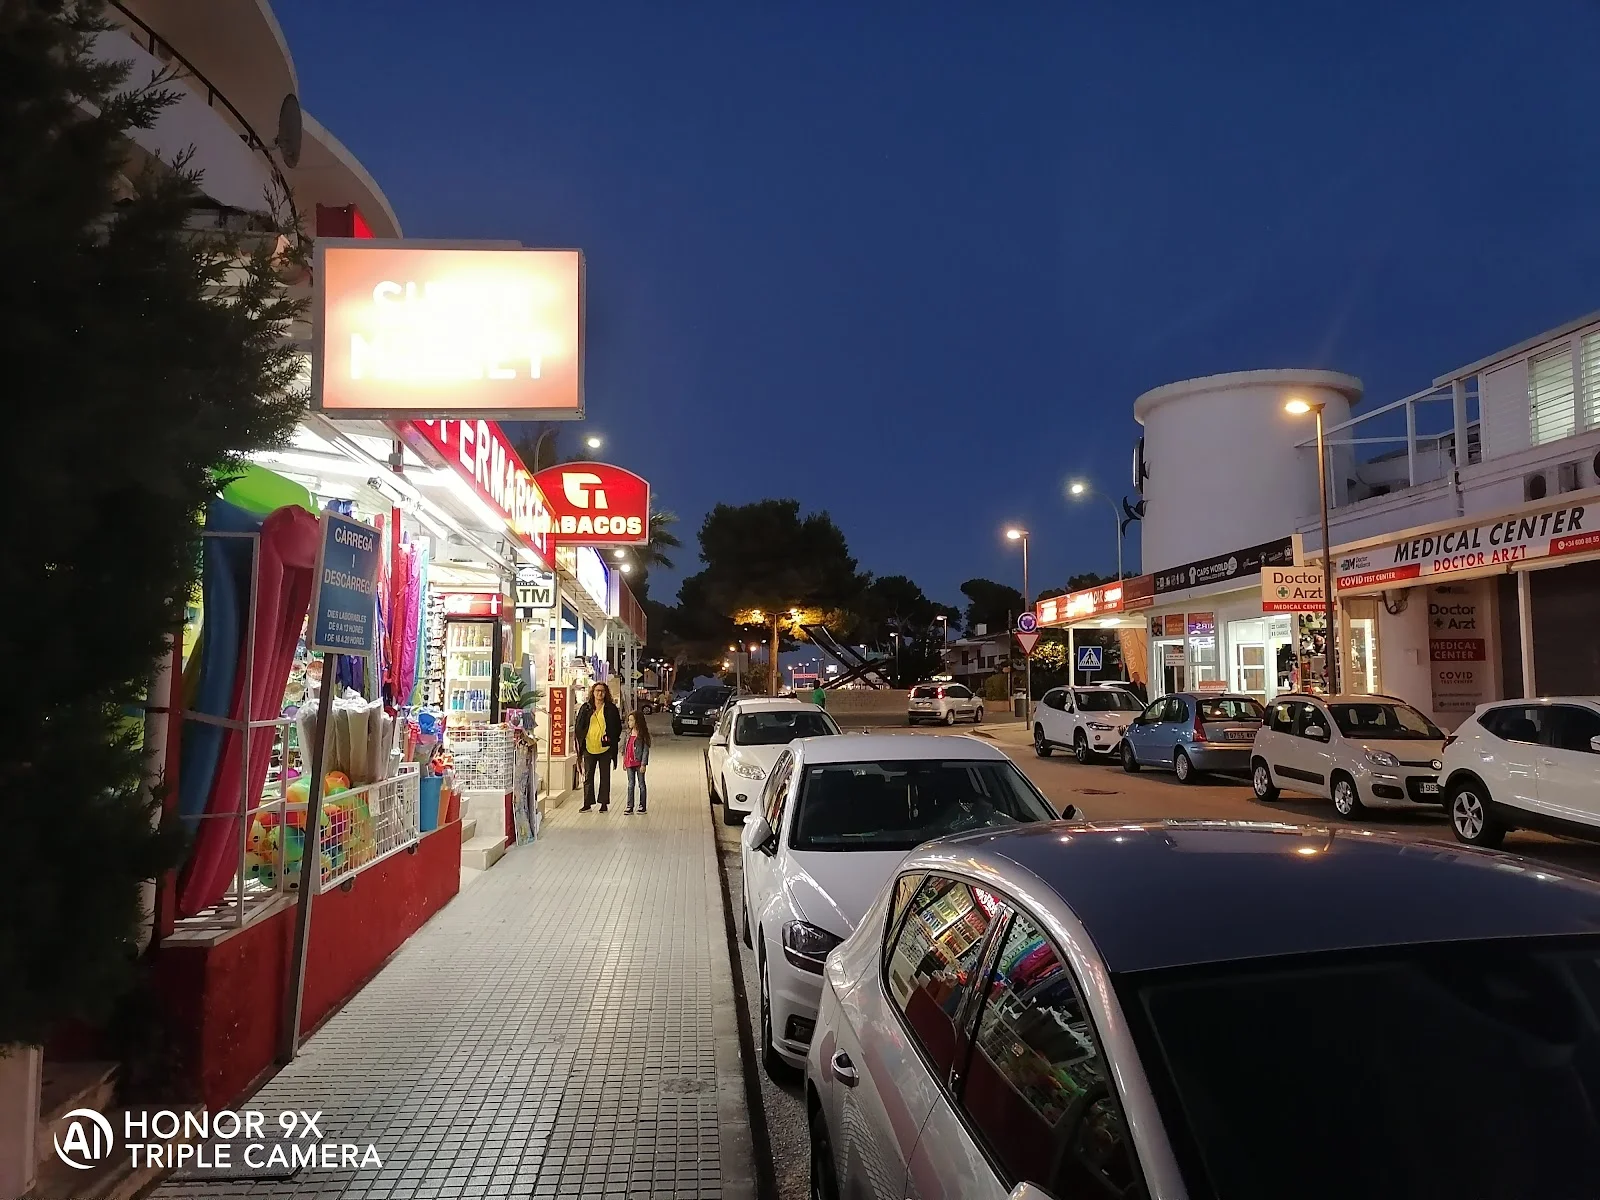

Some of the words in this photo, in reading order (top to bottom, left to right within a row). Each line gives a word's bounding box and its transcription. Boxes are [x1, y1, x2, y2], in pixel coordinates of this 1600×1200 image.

[1394, 529, 1481, 563] MEDICAL
[1489, 507, 1585, 546] CENTER
[1434, 552, 1484, 572] DOCTOR
[1491, 545, 1527, 563] ARZT
[1197, 566, 1209, 577] CAPS
[1209, 562, 1228, 573] WORLD
[324, 568, 373, 595] DESCÀRREGA
[1273, 572, 1323, 584] Doctor
[1340, 575, 1364, 587] COVID
[1364, 575, 1375, 583] TEST
[1375, 571, 1396, 581] CENTER
[516, 588, 550, 603] TM
[1293, 587, 1323, 599] Arzt
[1429, 604, 1475, 616] Doctor
[328, 621, 336, 630] DE
[1448, 617, 1476, 630] Arzt
[327, 633, 335, 642] DE
[1430, 641, 1477, 650] MEDICAL
[1434, 651, 1474, 659] CENTER
[1439, 671, 1473, 680] COVID
[552, 698, 563, 753] TABACOS
